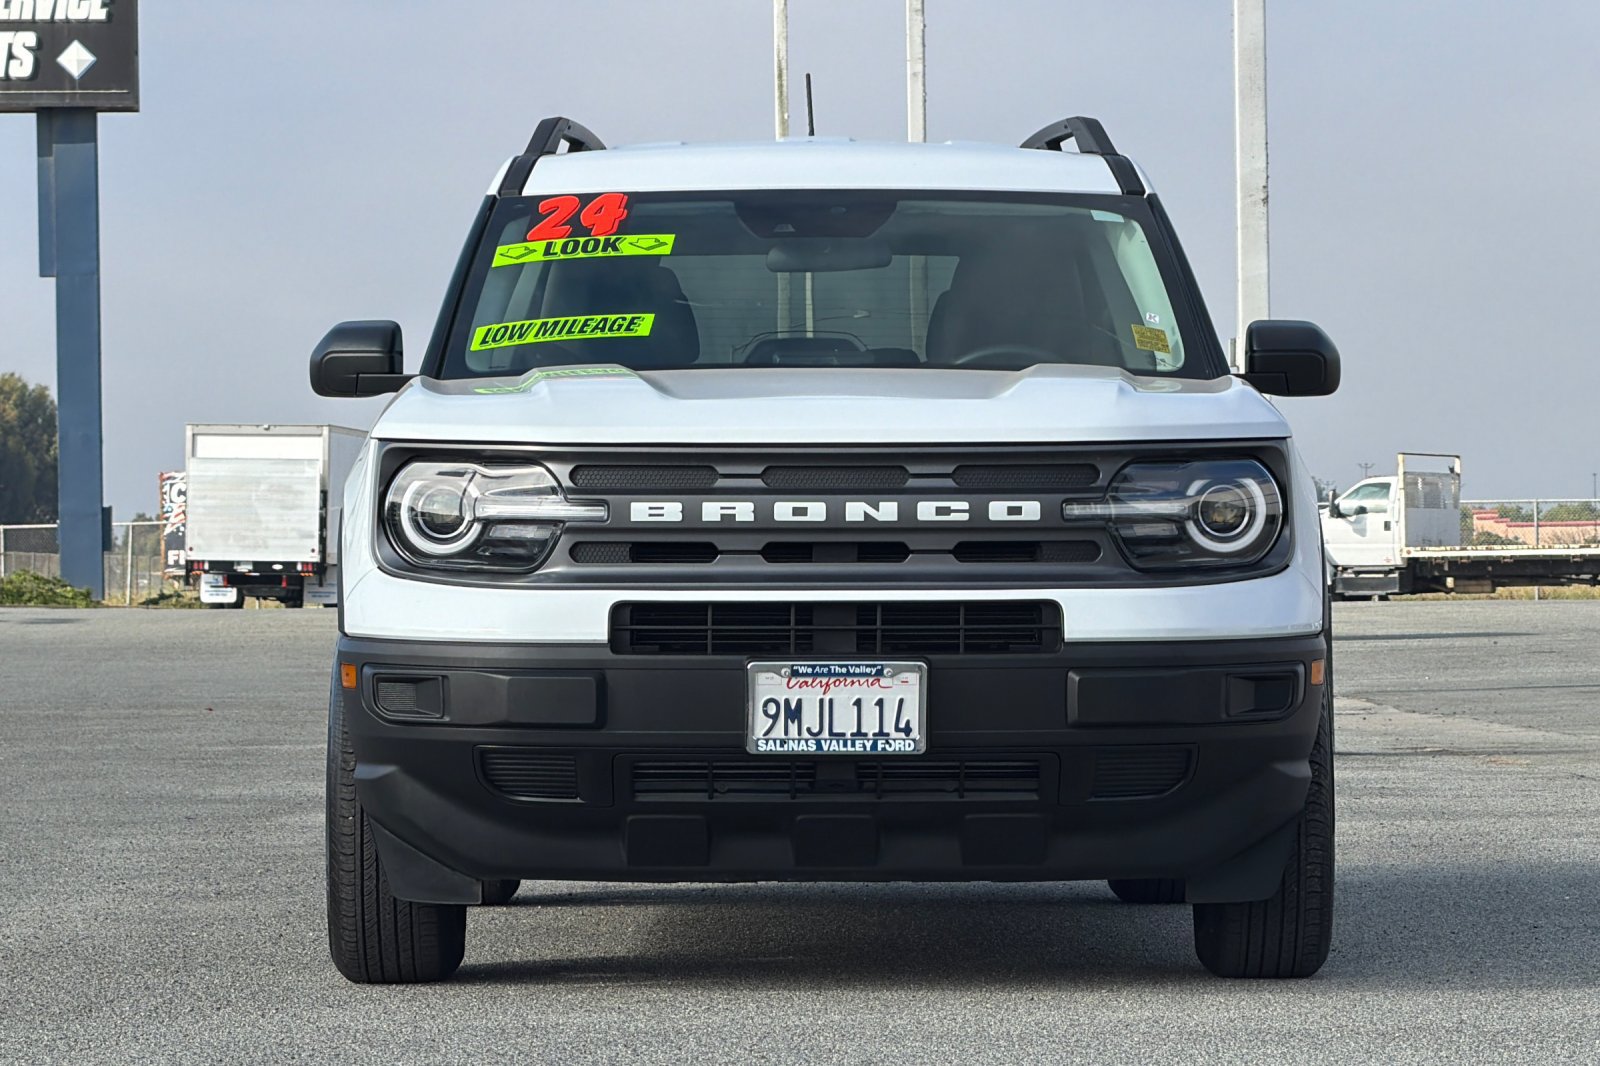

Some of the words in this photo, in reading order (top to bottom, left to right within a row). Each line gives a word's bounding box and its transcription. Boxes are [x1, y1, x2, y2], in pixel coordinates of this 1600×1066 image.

[527, 193, 628, 241] 24
[542, 237, 627, 258] LOOK
[479, 322, 536, 347] LOW
[534, 316, 645, 340] MILEAGE
[630, 500, 1041, 522] BRONCO
[813, 666, 829, 674] Are
[830, 666, 849, 674] The
[786, 677, 892, 695] California
[761, 697, 913, 737] 9MJL114
[757, 739, 817, 751] SALINAS
[821, 739, 873, 751] VALLEY
[877, 739, 915, 751] FORD
